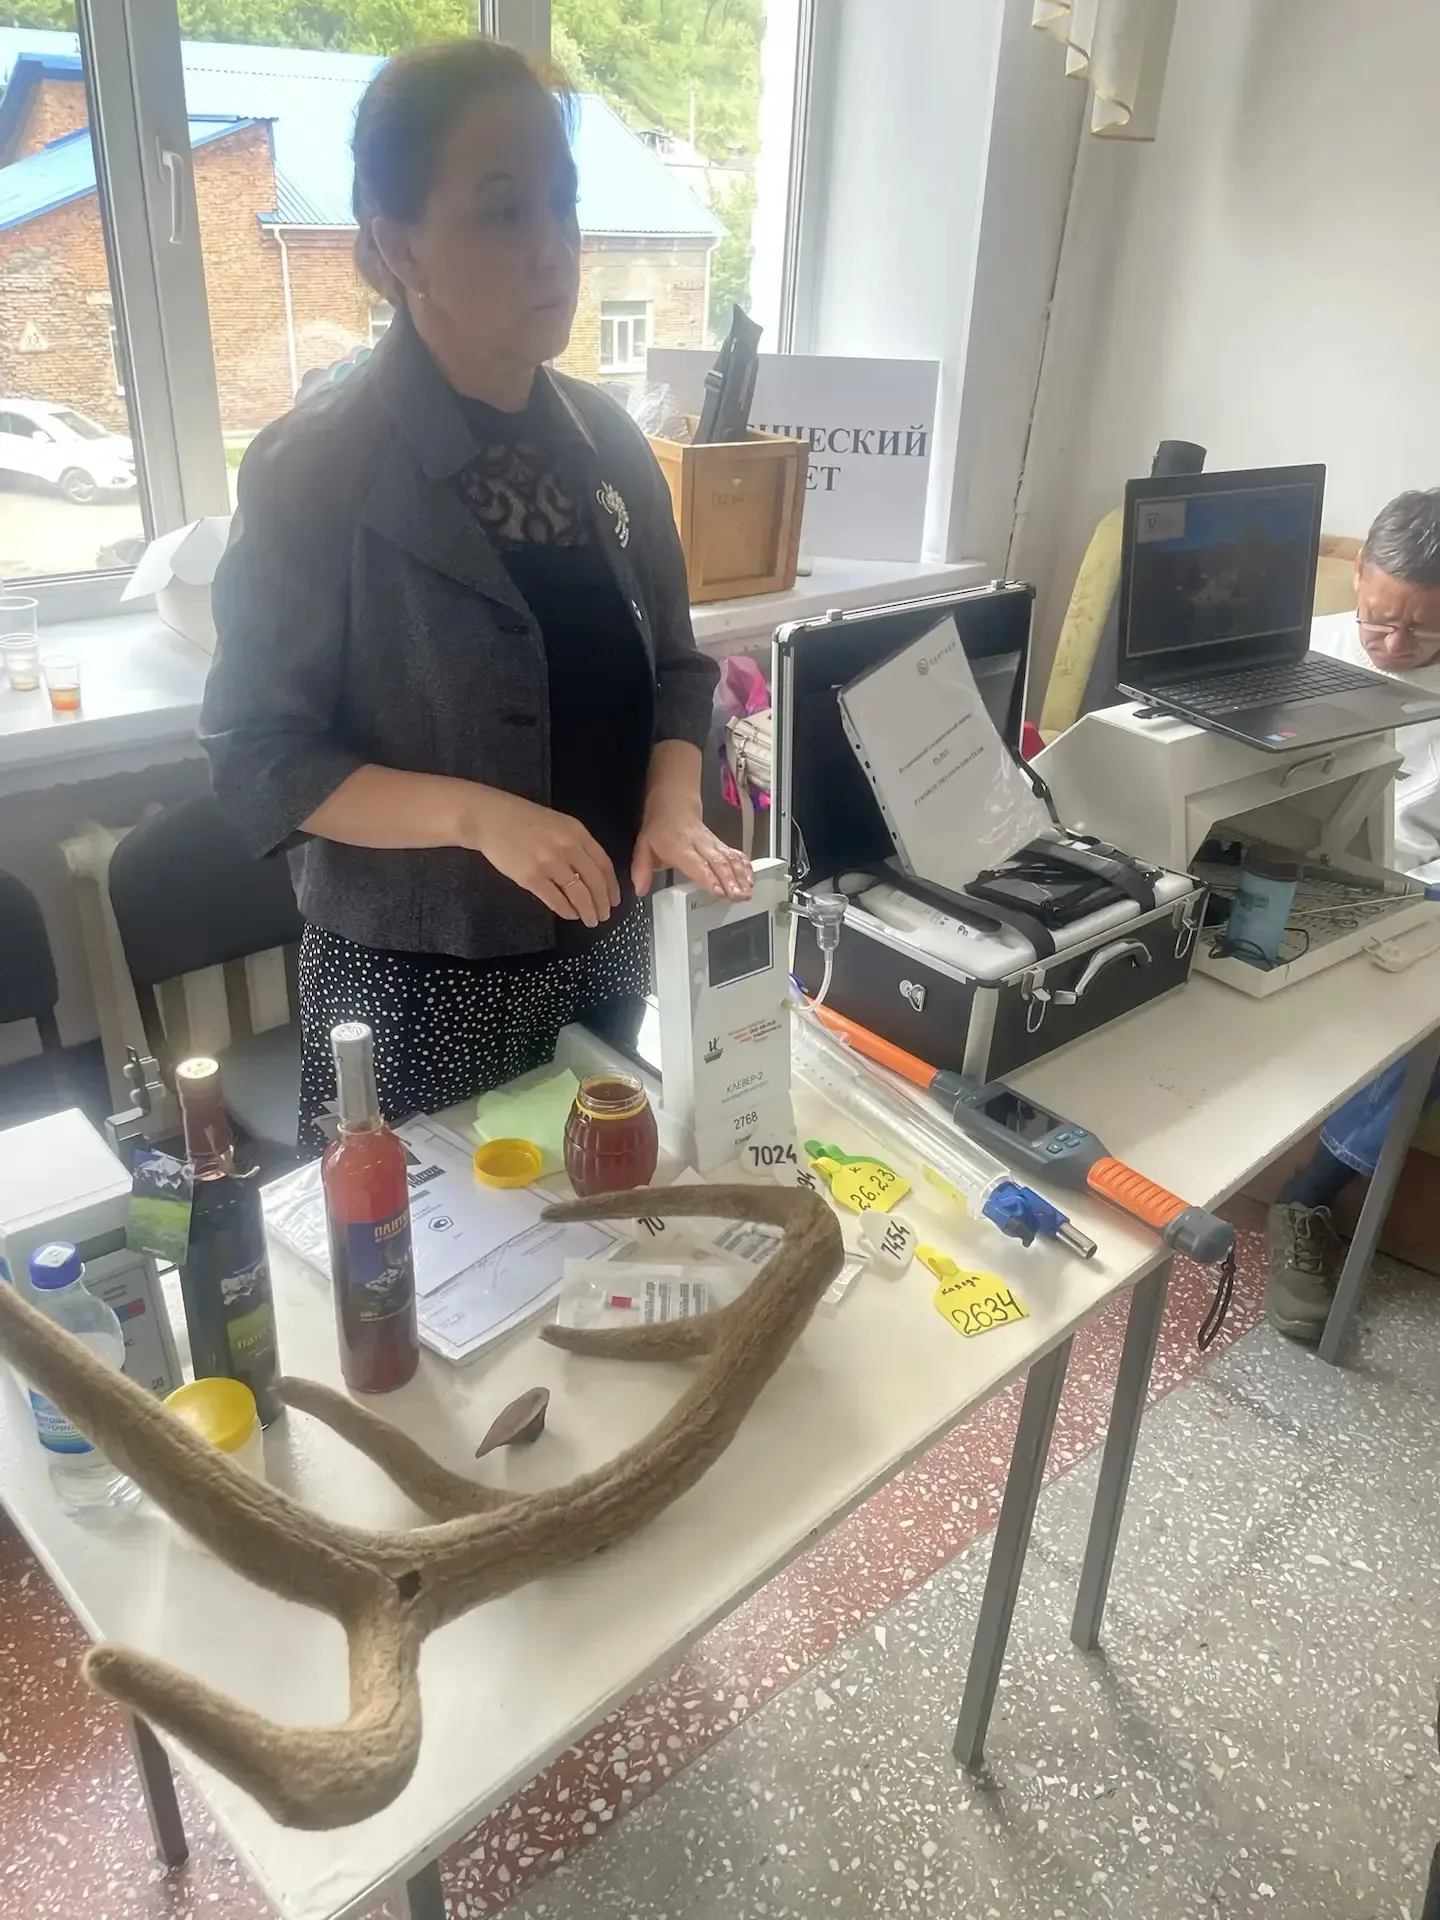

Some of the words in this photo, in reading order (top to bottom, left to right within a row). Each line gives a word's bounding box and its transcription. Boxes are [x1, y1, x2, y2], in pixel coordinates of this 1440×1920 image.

[733, 1111, 758, 1130] 2768
[748, 1144, 797, 1167] 7024
[951, 1289, 1024, 1335] 2634
